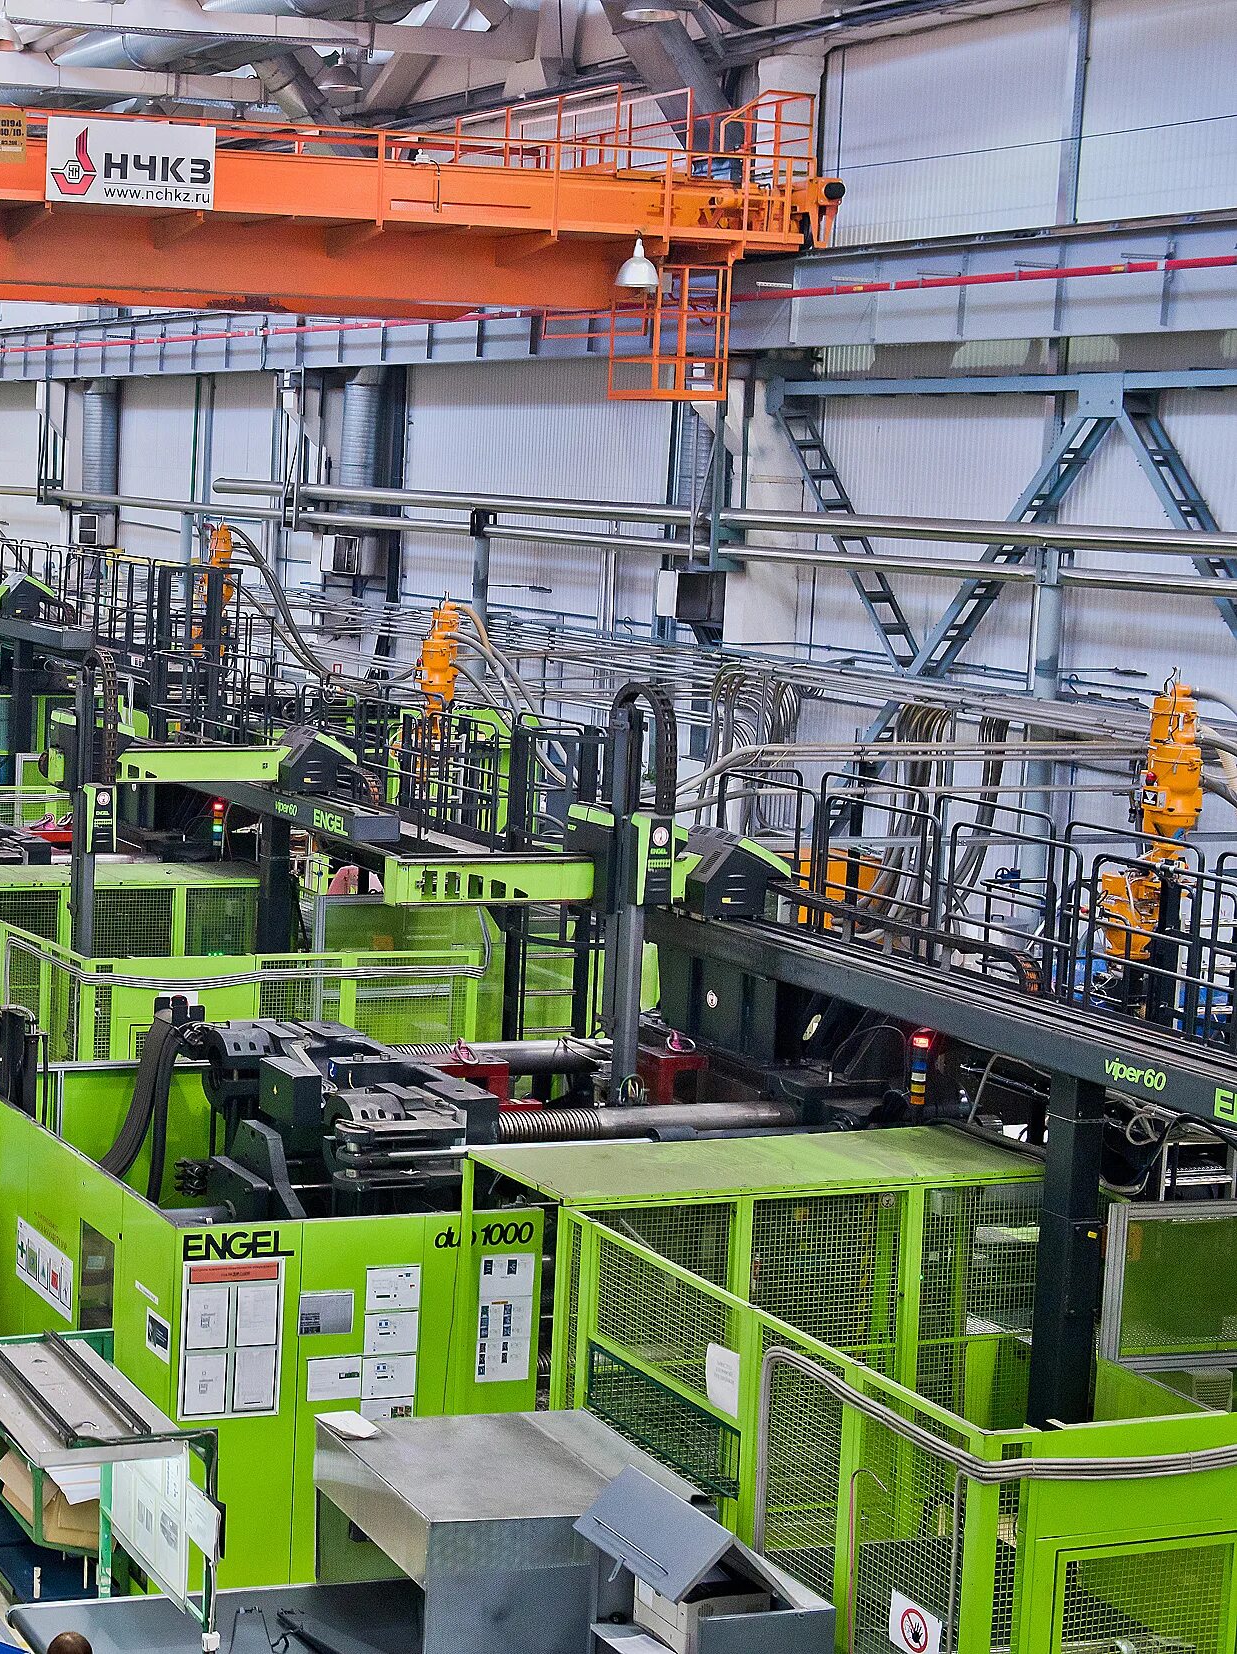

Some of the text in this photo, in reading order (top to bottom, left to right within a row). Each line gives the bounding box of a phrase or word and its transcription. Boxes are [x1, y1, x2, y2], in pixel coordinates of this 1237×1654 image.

[103, 152, 212, 184] НЧКЗ
[103, 186, 211, 204] www.nchkz.ru
[313, 808, 349, 836] ENGEL
[182, 1230, 295, 1262] ENGEL
[481, 1221, 535, 1246] 1000
